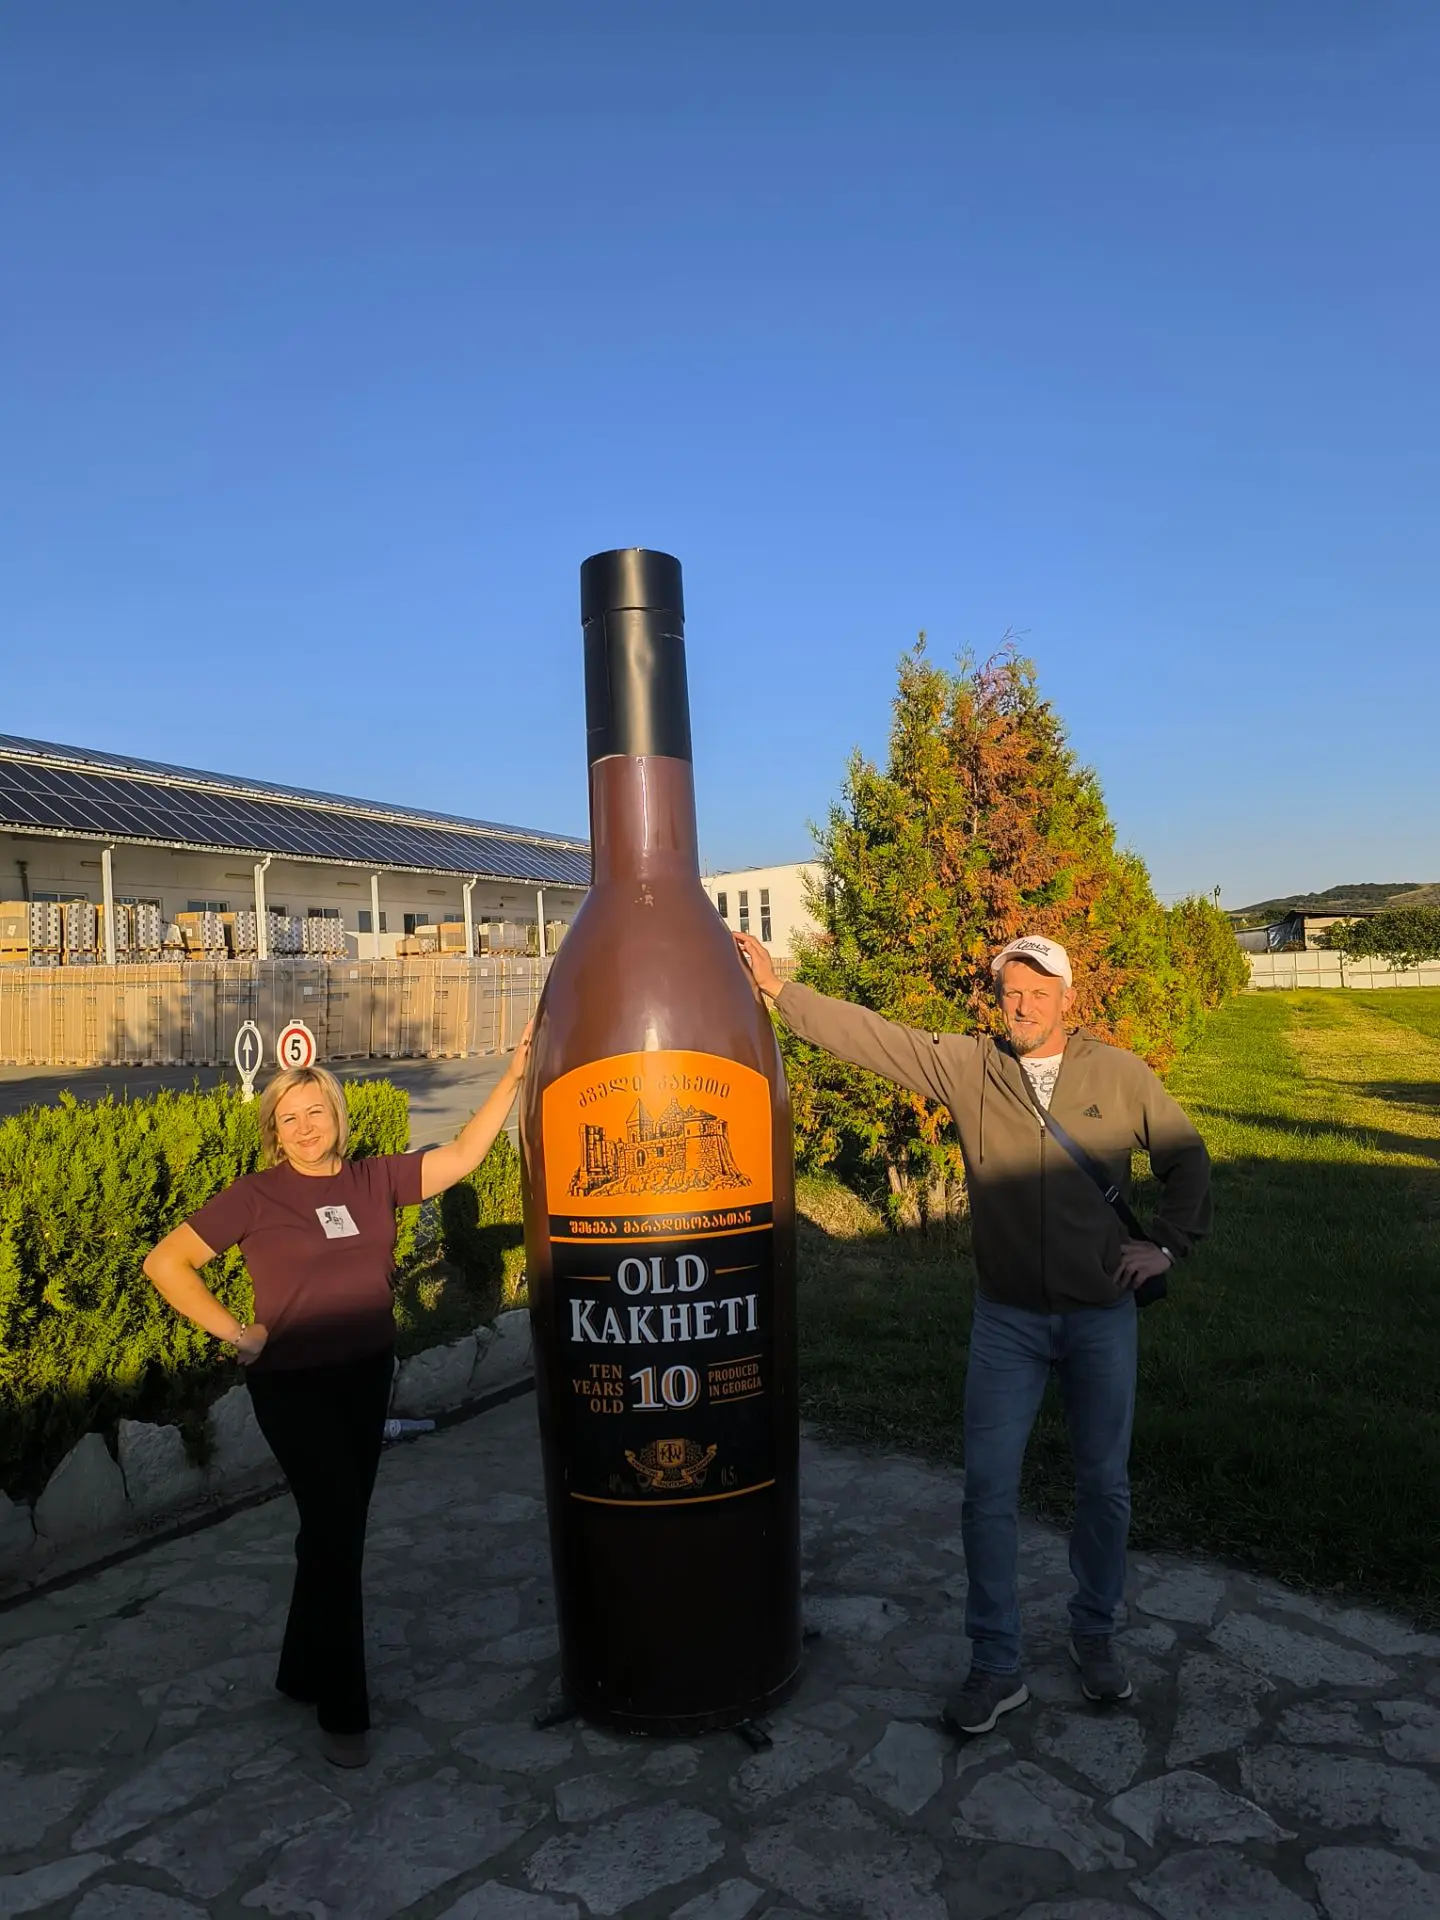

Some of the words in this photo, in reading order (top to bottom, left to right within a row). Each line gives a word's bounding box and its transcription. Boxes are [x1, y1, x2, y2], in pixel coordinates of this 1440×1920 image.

[290, 1038, 301, 1061] 5
[578, 1075, 642, 1107] ძველი
[617, 1254, 709, 1296] OLD
[569, 1293, 759, 1344] KAKHETI
[589, 1363, 622, 1379] TEN
[708, 1362, 759, 1383] PRODUCED
[572, 1379, 624, 1396] YEARS
[629, 1364, 701, 1412] 10
[708, 1384, 720, 1398] IN
[722, 1379, 762, 1395] GEORGIA
[590, 1398, 624, 1414] OLD
